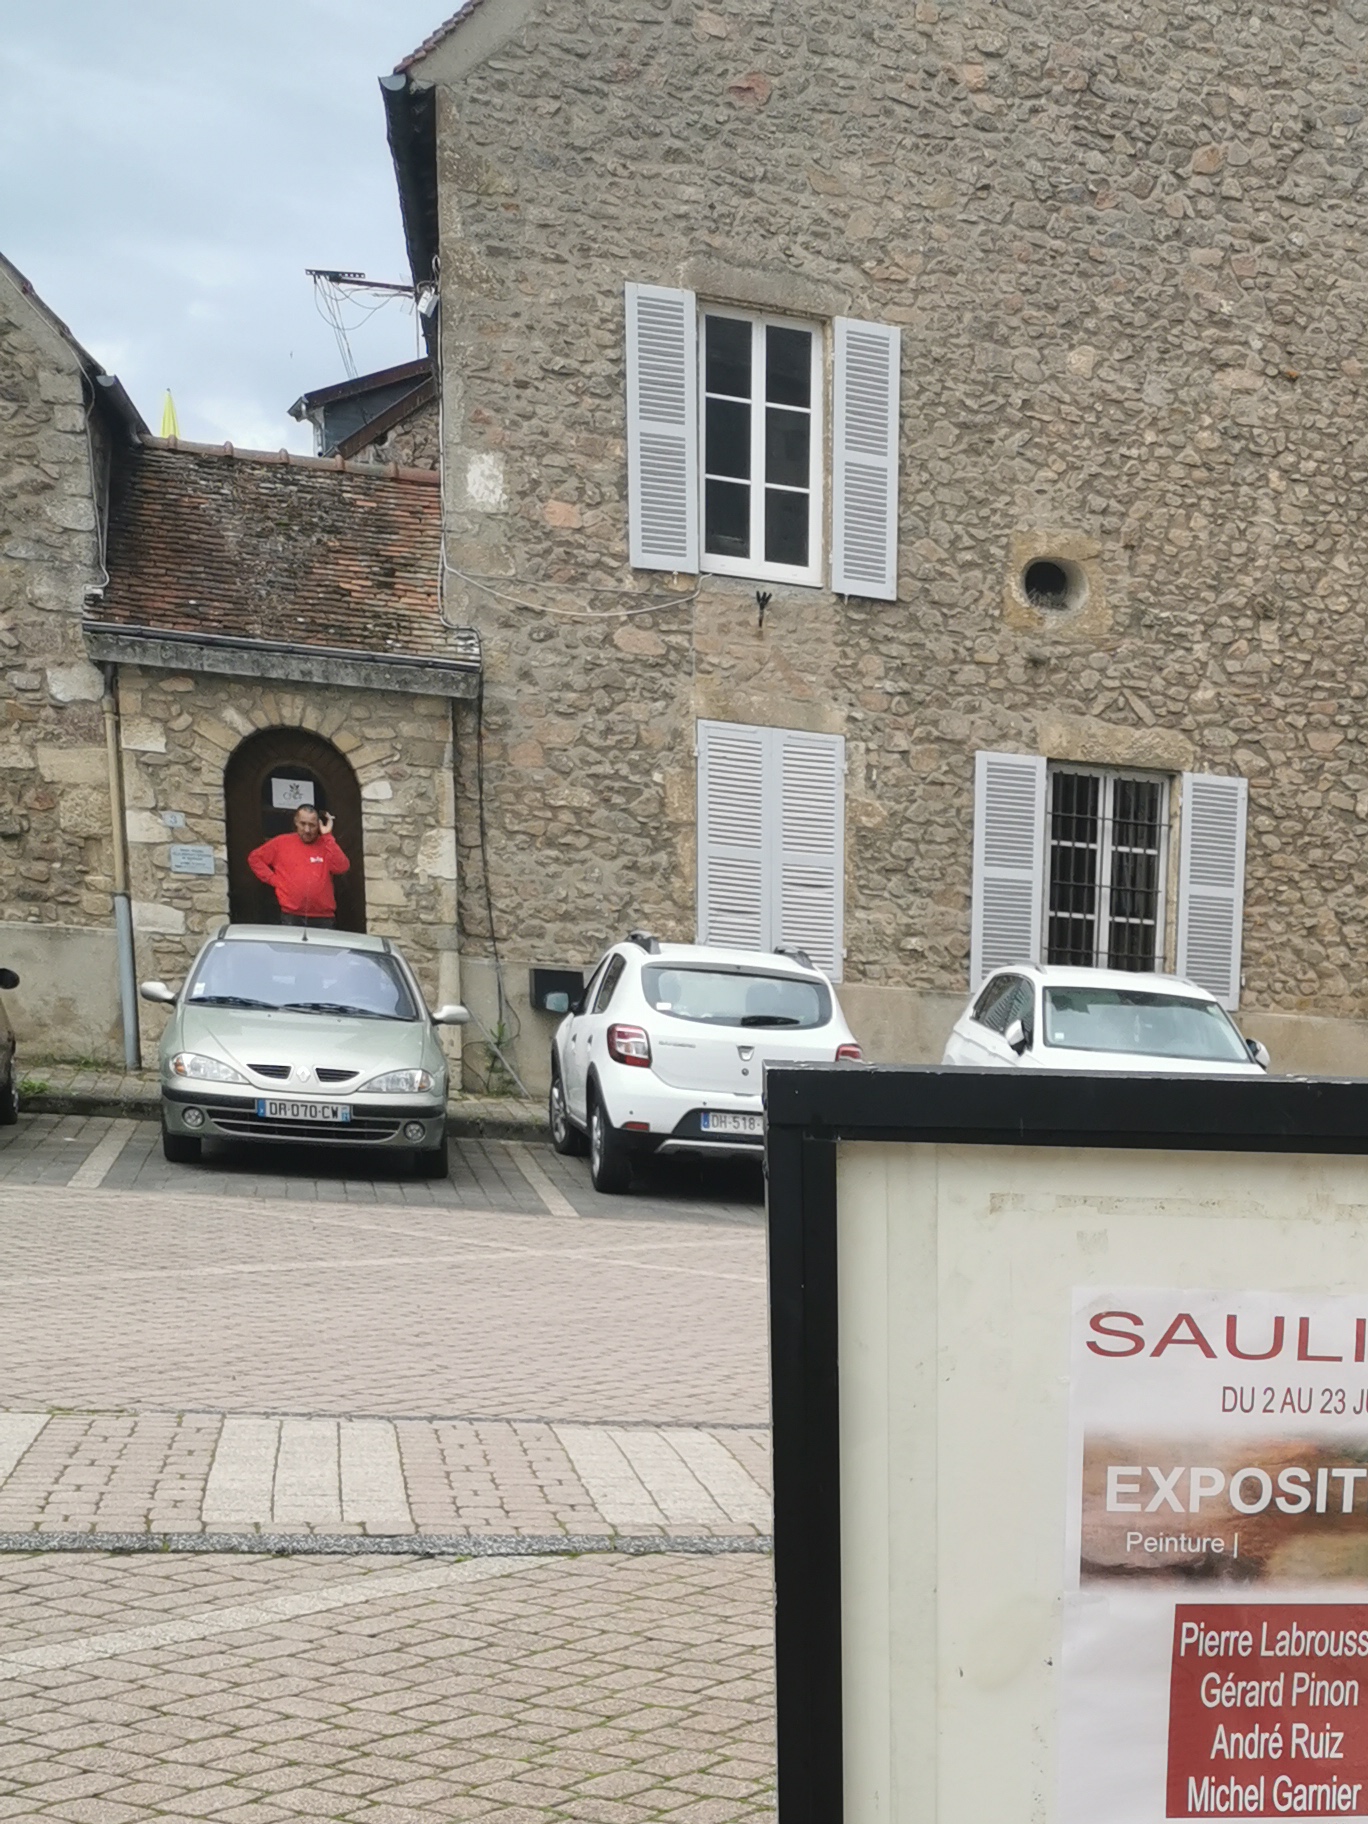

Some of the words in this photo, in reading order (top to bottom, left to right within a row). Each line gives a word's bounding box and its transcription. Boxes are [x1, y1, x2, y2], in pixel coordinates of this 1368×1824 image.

[269, 1102, 339, 1119] DR-070-CW
[711, 1114, 761, 1131] DH-518-
[1221, 1386, 1255, 1413] DU
[1262, 1387, 1275, 1414] 2
[1279, 1387, 1312, 1414] AU
[1320, 1389, 1346, 1415] 23
[1126, 1532, 1225, 1553] Peinture
[1179, 1621, 1252, 1657] Pierre
[1201, 1672, 1284, 1708] Gérard
[1291, 1672, 1359, 1706] Pinon
[1210, 1723, 1283, 1760] André
[1290, 1723, 1344, 1759] Ruiz
[1187, 1776, 1264, 1812] Michel
[1273, 1775, 1362, 1811] Garnier
